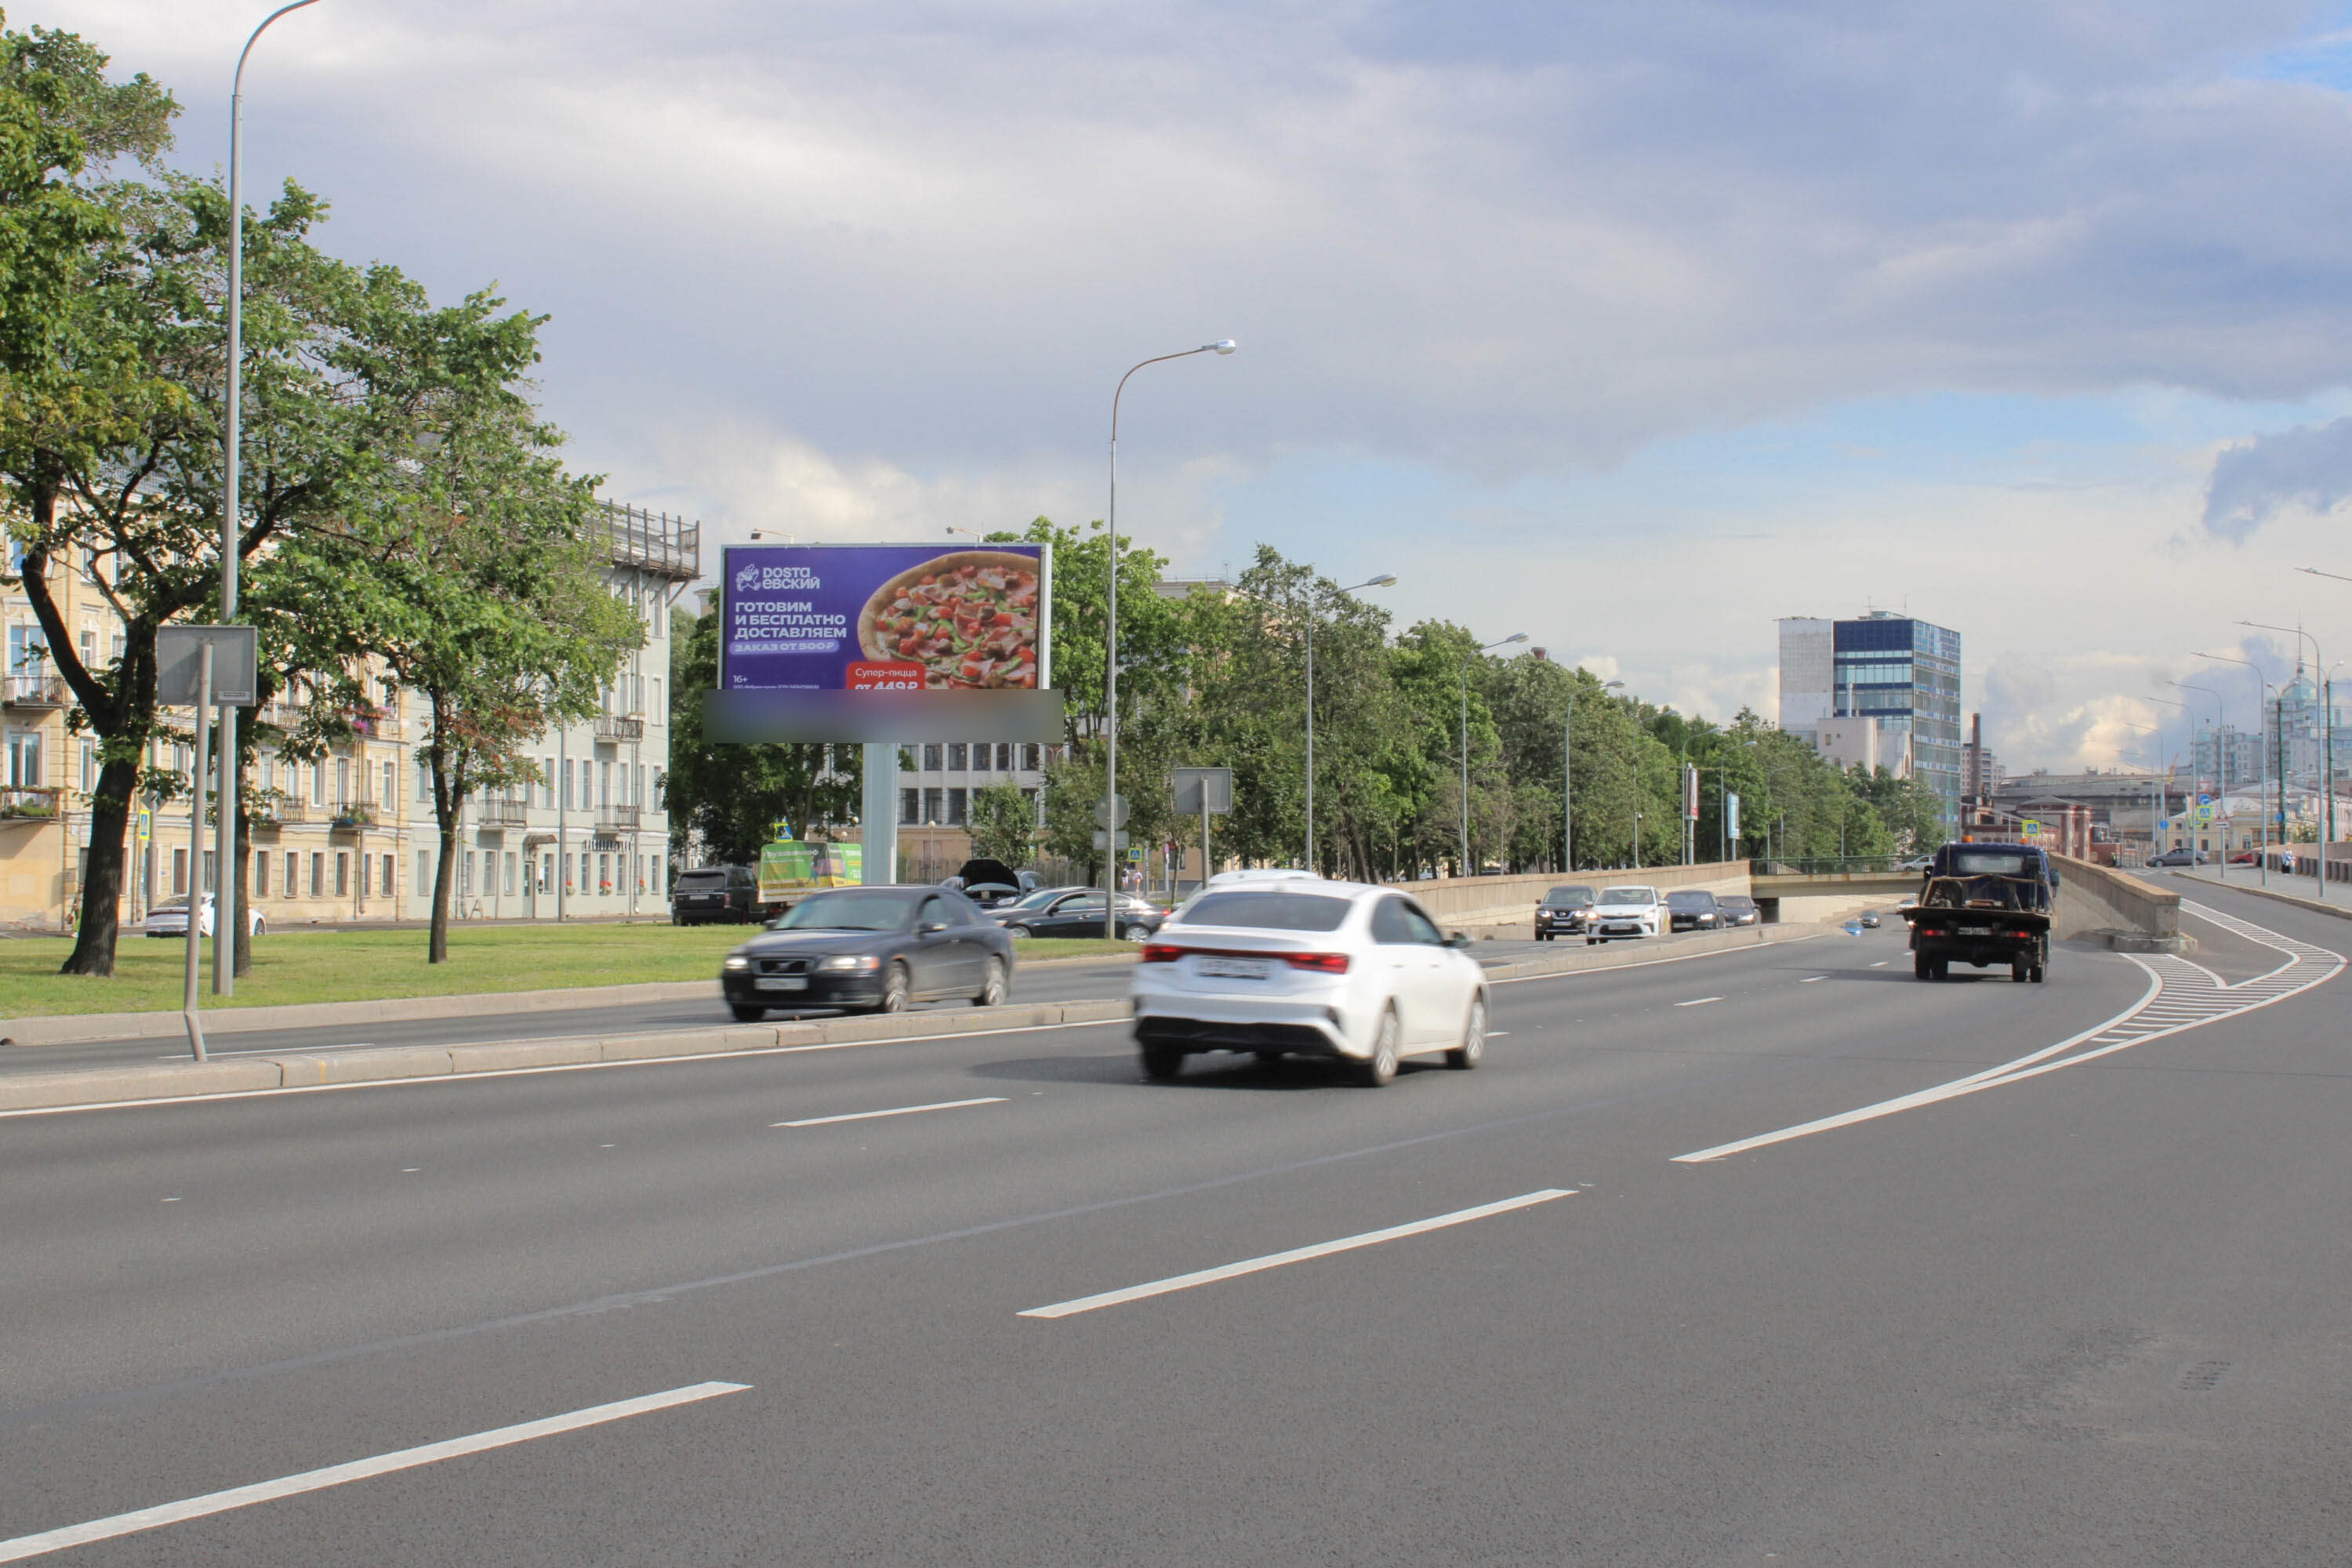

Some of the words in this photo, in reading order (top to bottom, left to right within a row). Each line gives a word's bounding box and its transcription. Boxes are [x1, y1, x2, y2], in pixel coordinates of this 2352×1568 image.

[735, 601, 812, 612] ГОТОВИМ
[735, 615, 746, 625] И
[750, 614, 846, 625] БЕСПЛАТНО
[735, 627, 847, 640] ДОСТАВЛЯЕМ
[735, 643, 778, 652] ЗАКАЗ
[780, 642, 797, 651] ОТ
